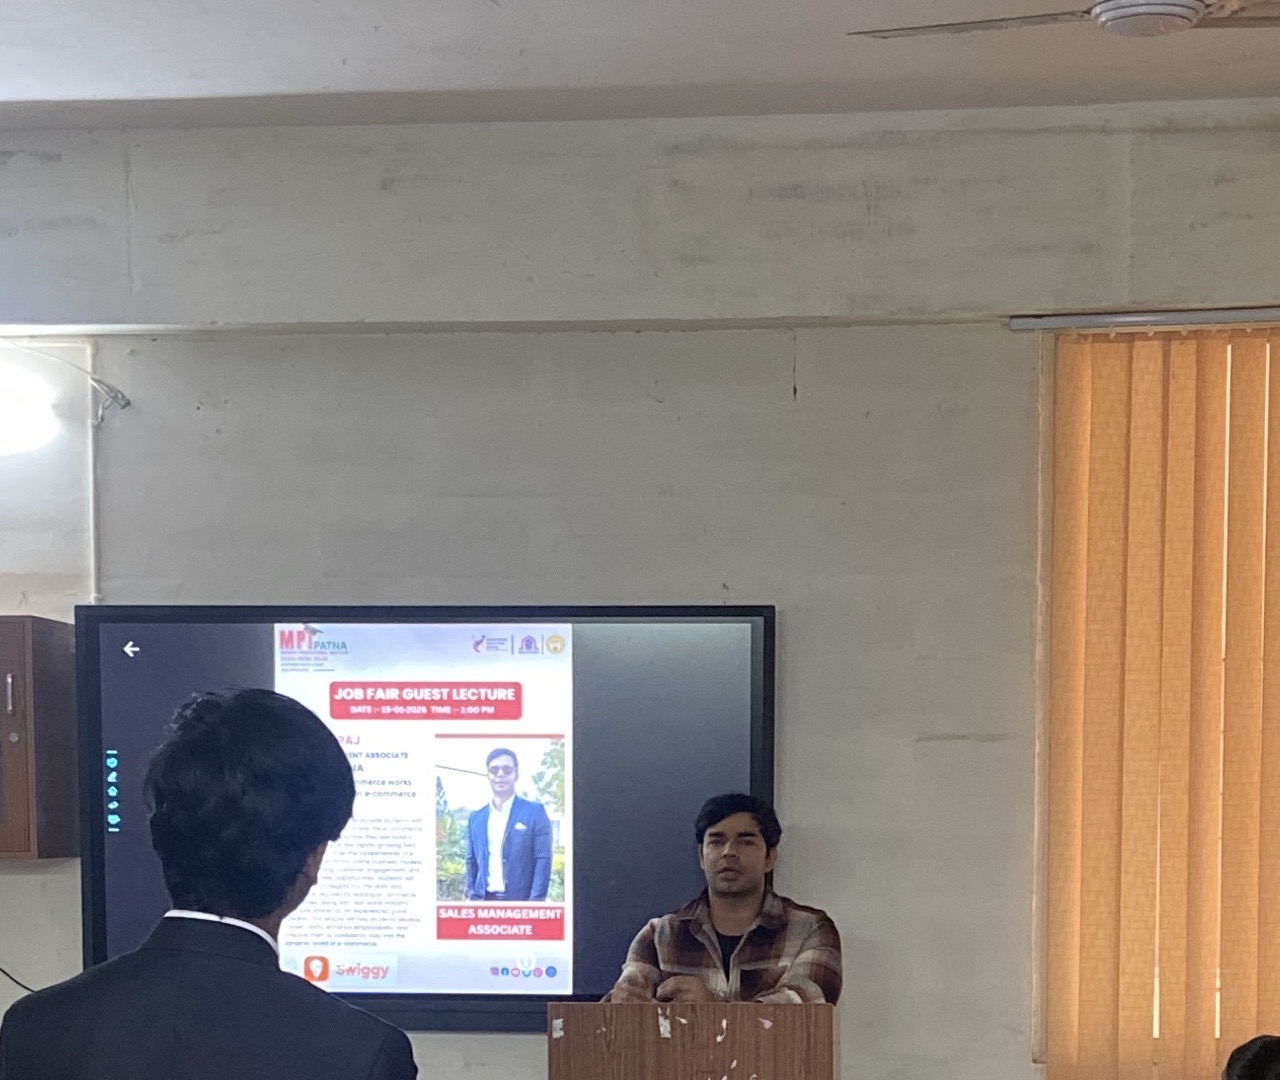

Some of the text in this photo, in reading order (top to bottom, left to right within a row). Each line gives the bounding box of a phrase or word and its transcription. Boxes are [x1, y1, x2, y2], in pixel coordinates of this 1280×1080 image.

[279, 630, 348, 650] MPI PATNA
[333, 688, 516, 701] JOB FAIR GUEST LECTURE
[349, 705, 372, 714] DATE
[430, 705, 452, 714] TIME
[460, 705, 481, 714] 1:00
[481, 705, 496, 714] PM
[388, 778, 412, 786] works
[364, 790, 417, 798] e-commerce
[438, 908, 562, 920] SALES MANAGEMENT
[468, 924, 533, 936] ASSOCIATE
[335, 962, 389, 980] Swiggy
